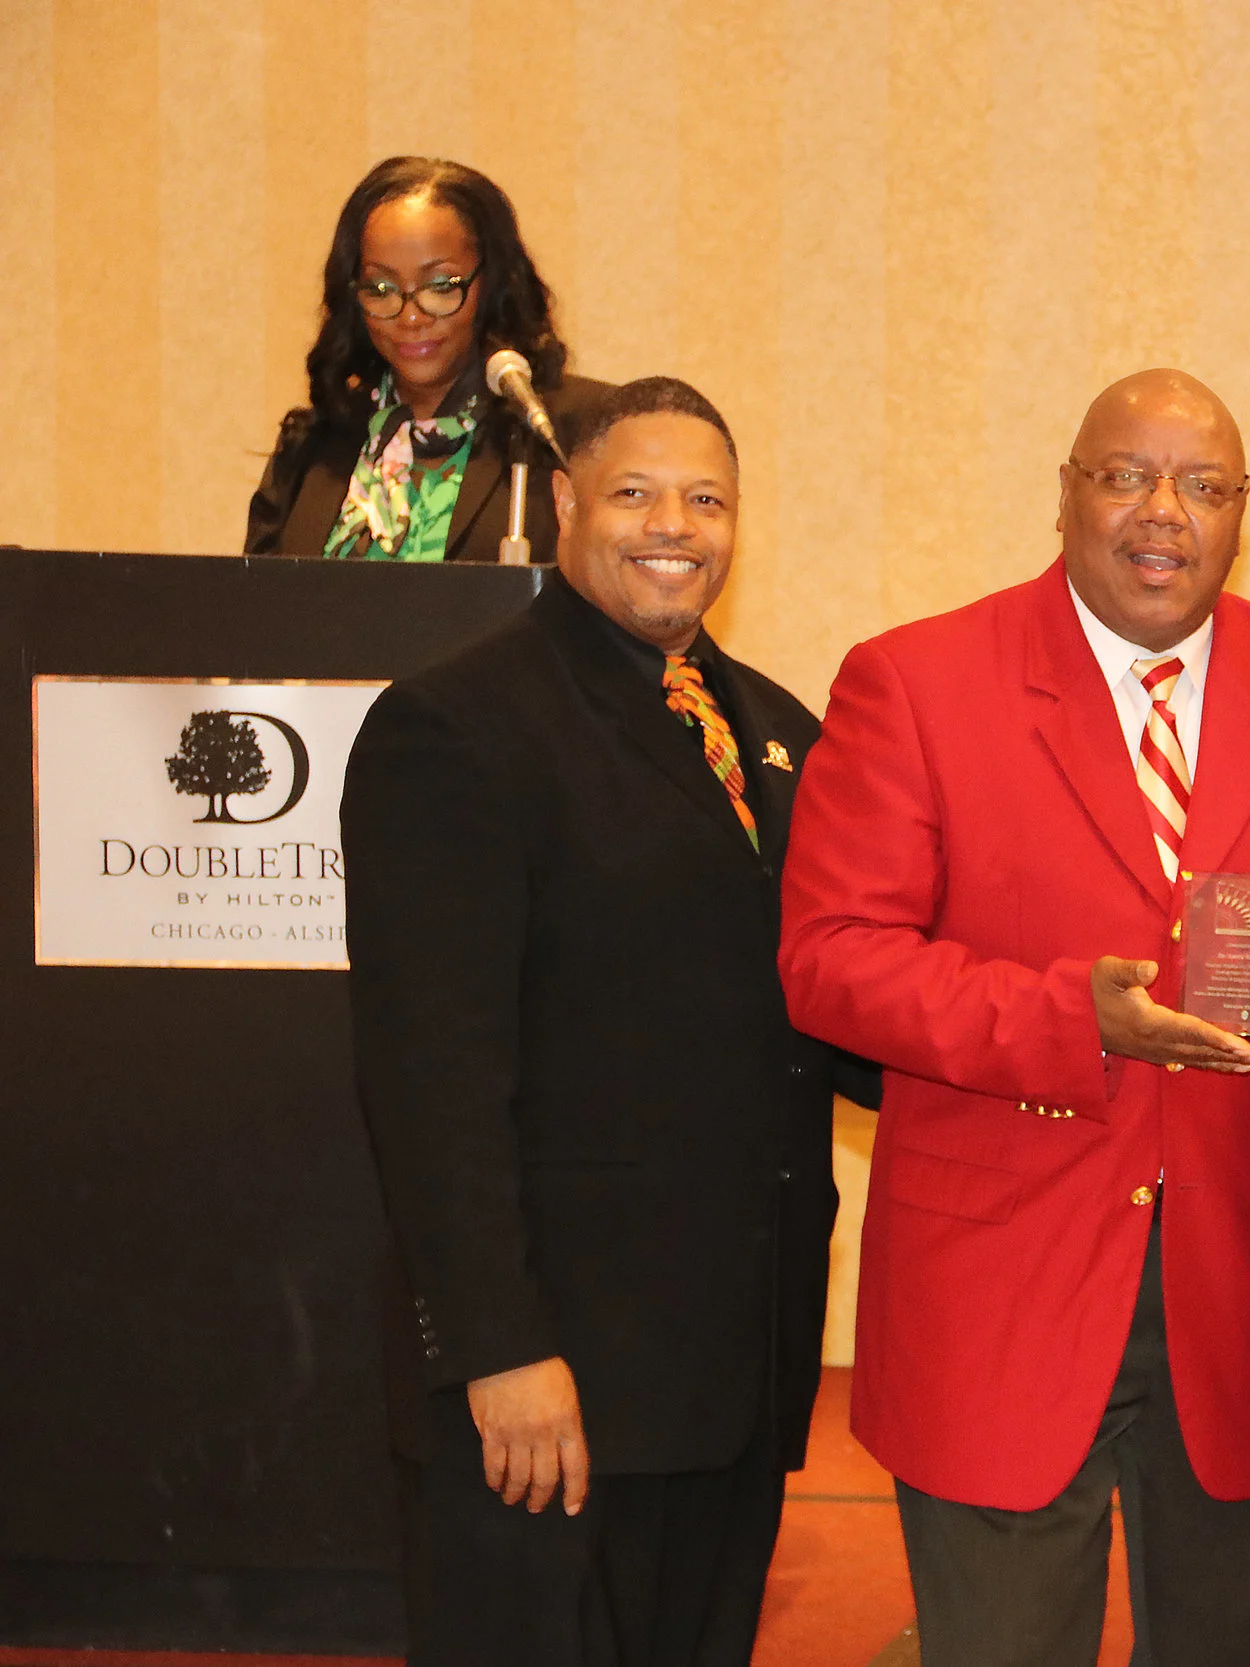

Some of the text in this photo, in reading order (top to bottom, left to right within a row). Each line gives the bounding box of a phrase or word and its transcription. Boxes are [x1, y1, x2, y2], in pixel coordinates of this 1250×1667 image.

[99, 839, 345, 879] DOUBLETR
[177, 892, 208, 905] BY
[151, 922, 263, 941] CHICAGO
